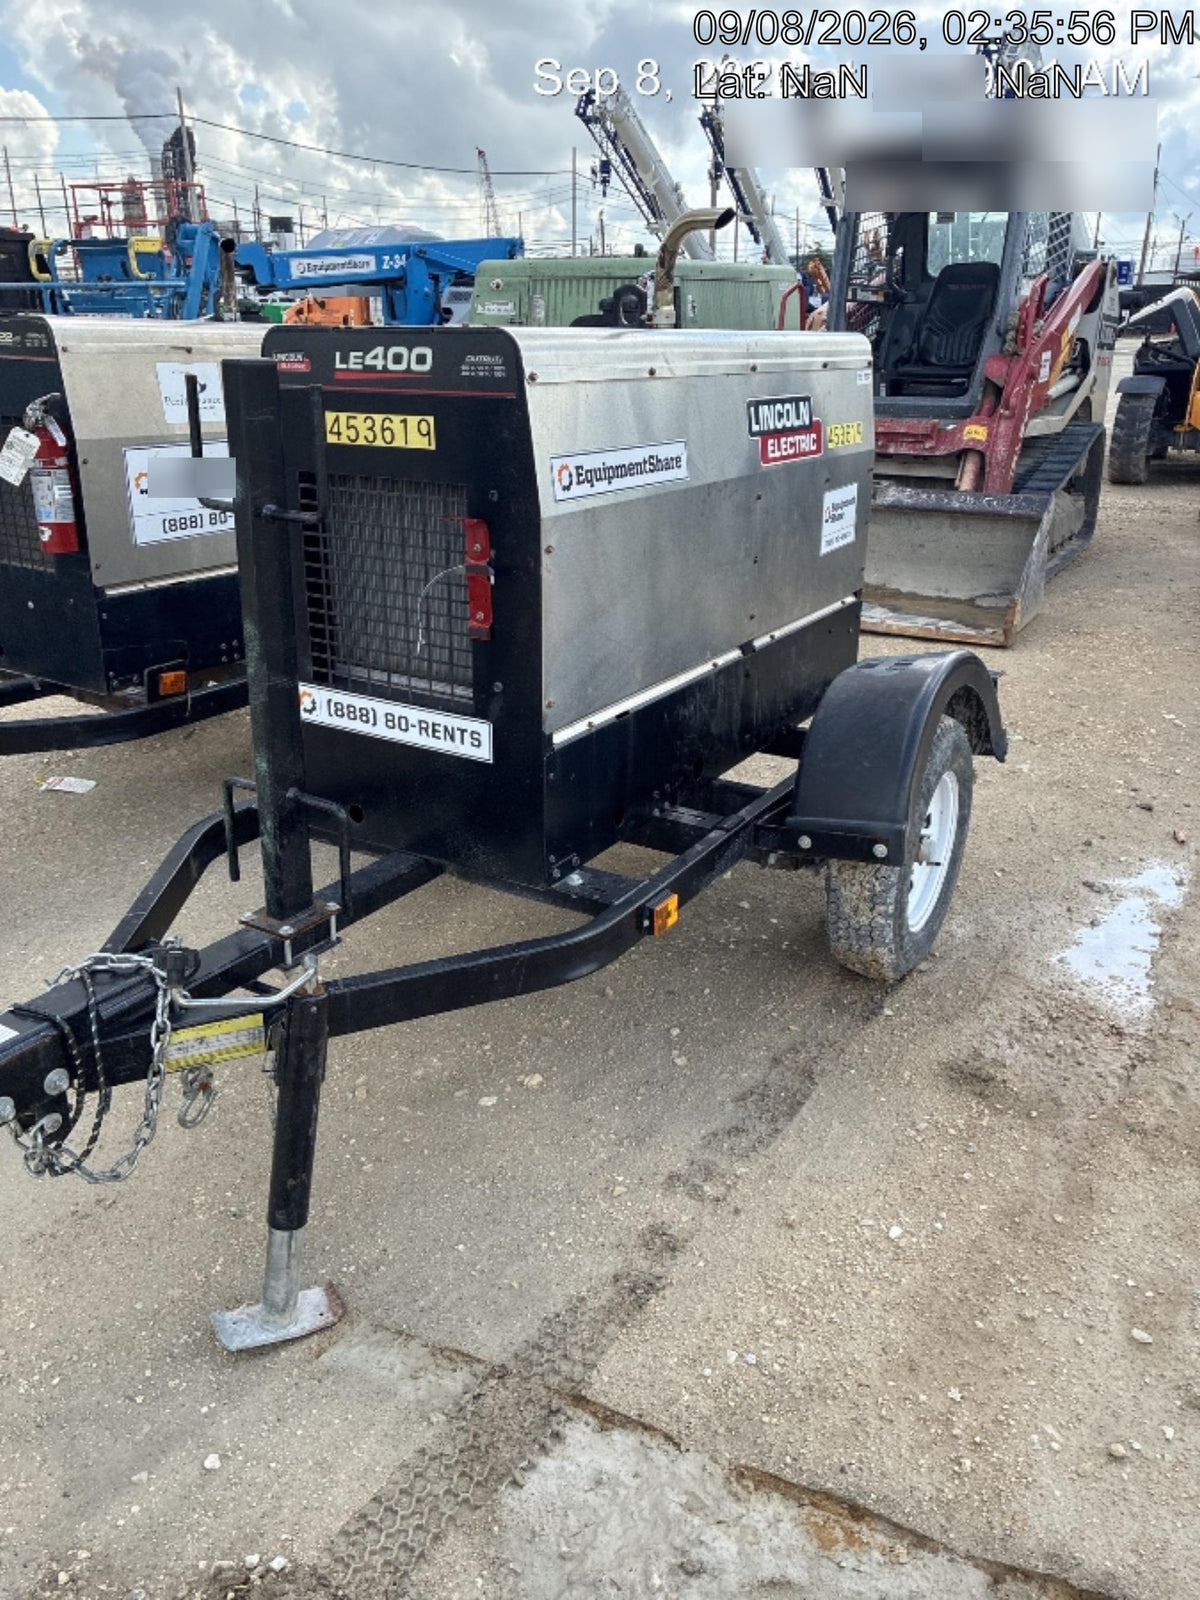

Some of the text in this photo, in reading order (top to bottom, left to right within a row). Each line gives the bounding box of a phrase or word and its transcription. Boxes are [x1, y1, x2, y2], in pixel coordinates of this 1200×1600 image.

[335, 345, 433, 371] LE400
[328, 415, 433, 447] 453619
[749, 400, 810, 433] LINCOLN
[767, 432, 817, 458] ELECTRIC
[575, 455, 683, 488] EquipmentShare
[162, 511, 235, 534] (888) 80-
[326, 698, 482, 749] (888) 80-RENTS
